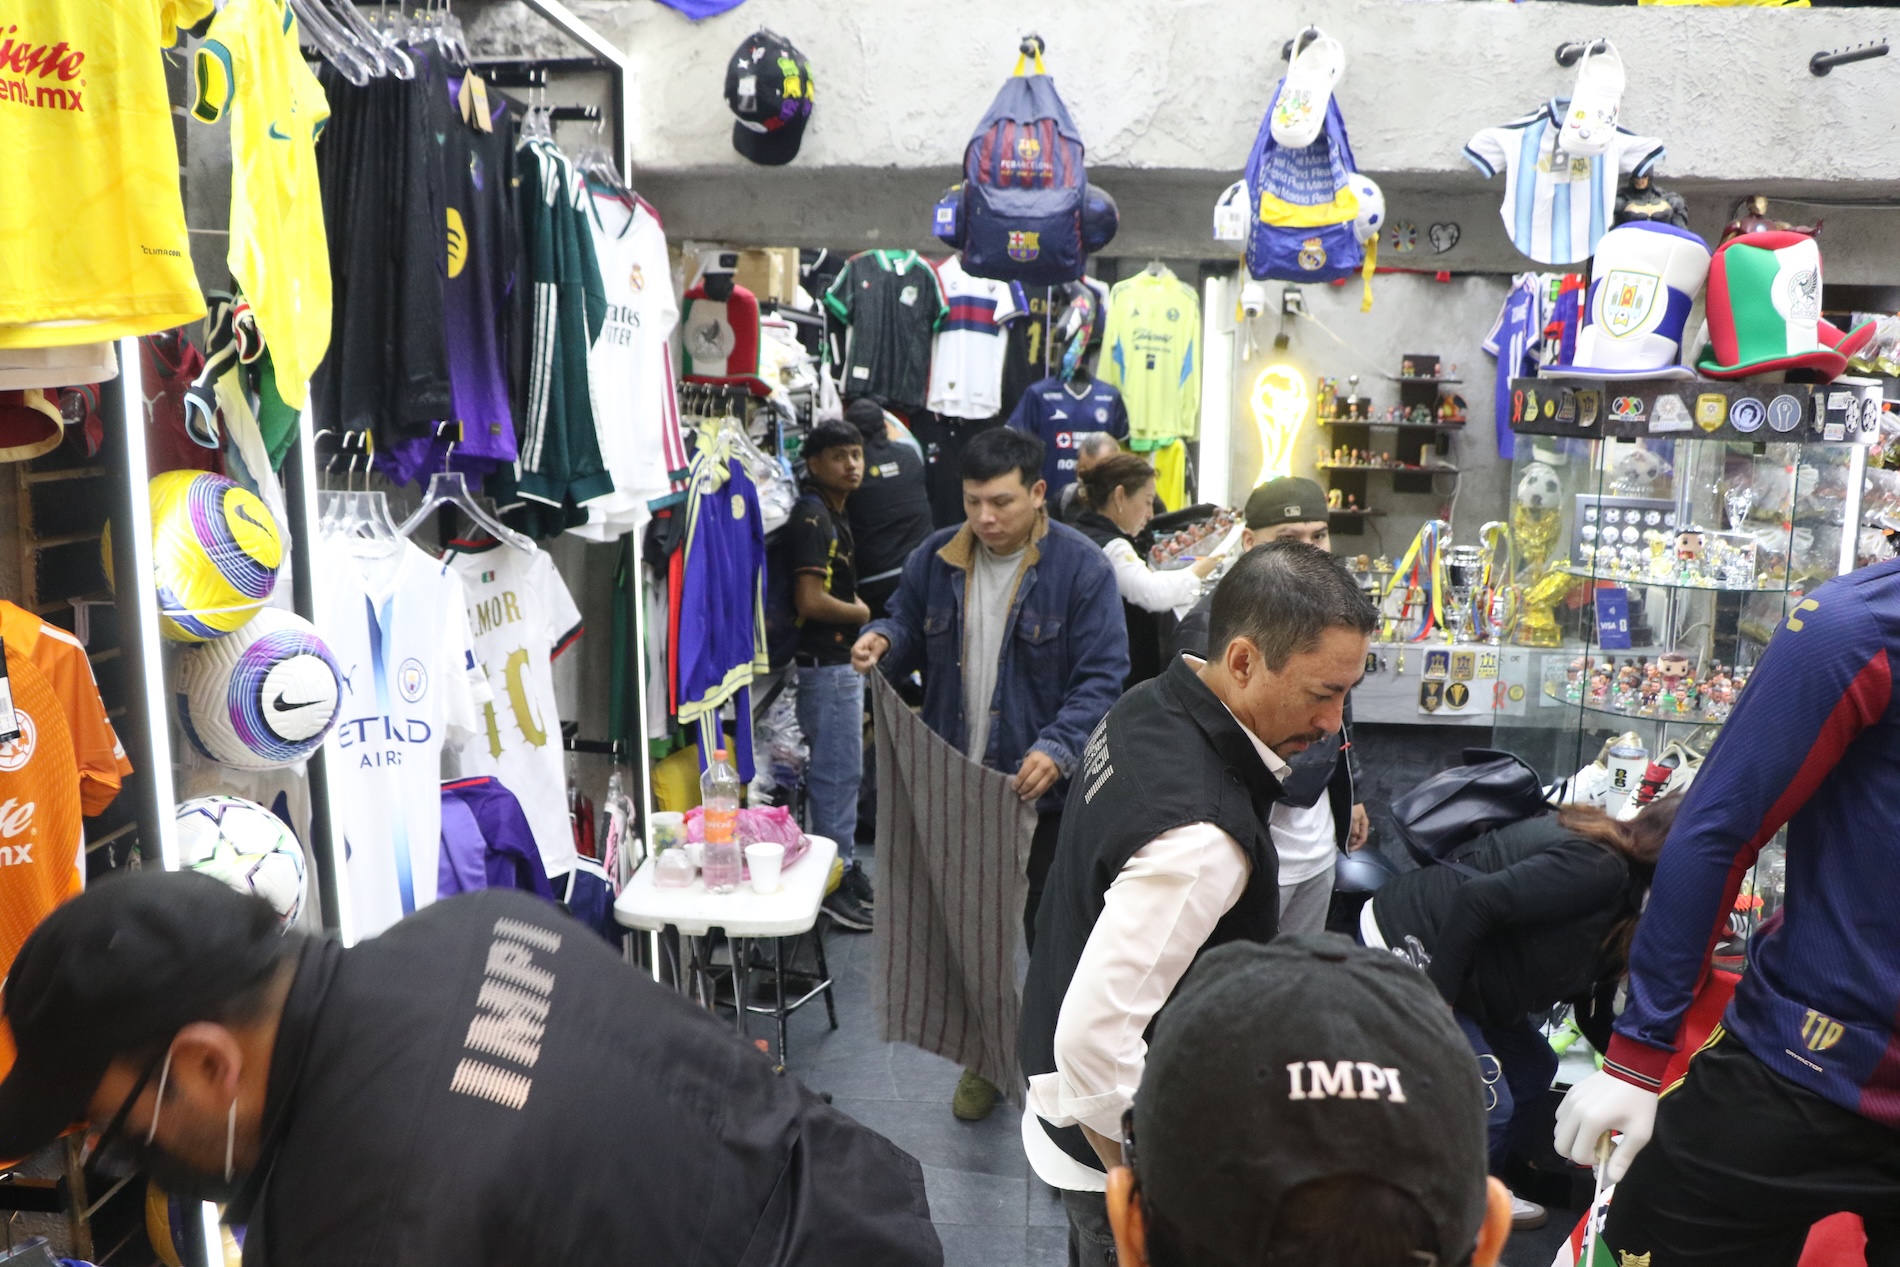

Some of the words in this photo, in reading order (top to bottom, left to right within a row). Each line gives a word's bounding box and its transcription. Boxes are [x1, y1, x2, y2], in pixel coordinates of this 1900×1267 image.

[467, 591, 522, 637] .MOR
[1600, 622, 1617, 630] VISA
[450, 916, 563, 1111] IMPI
[1286, 1060, 1407, 1104] IMPI
